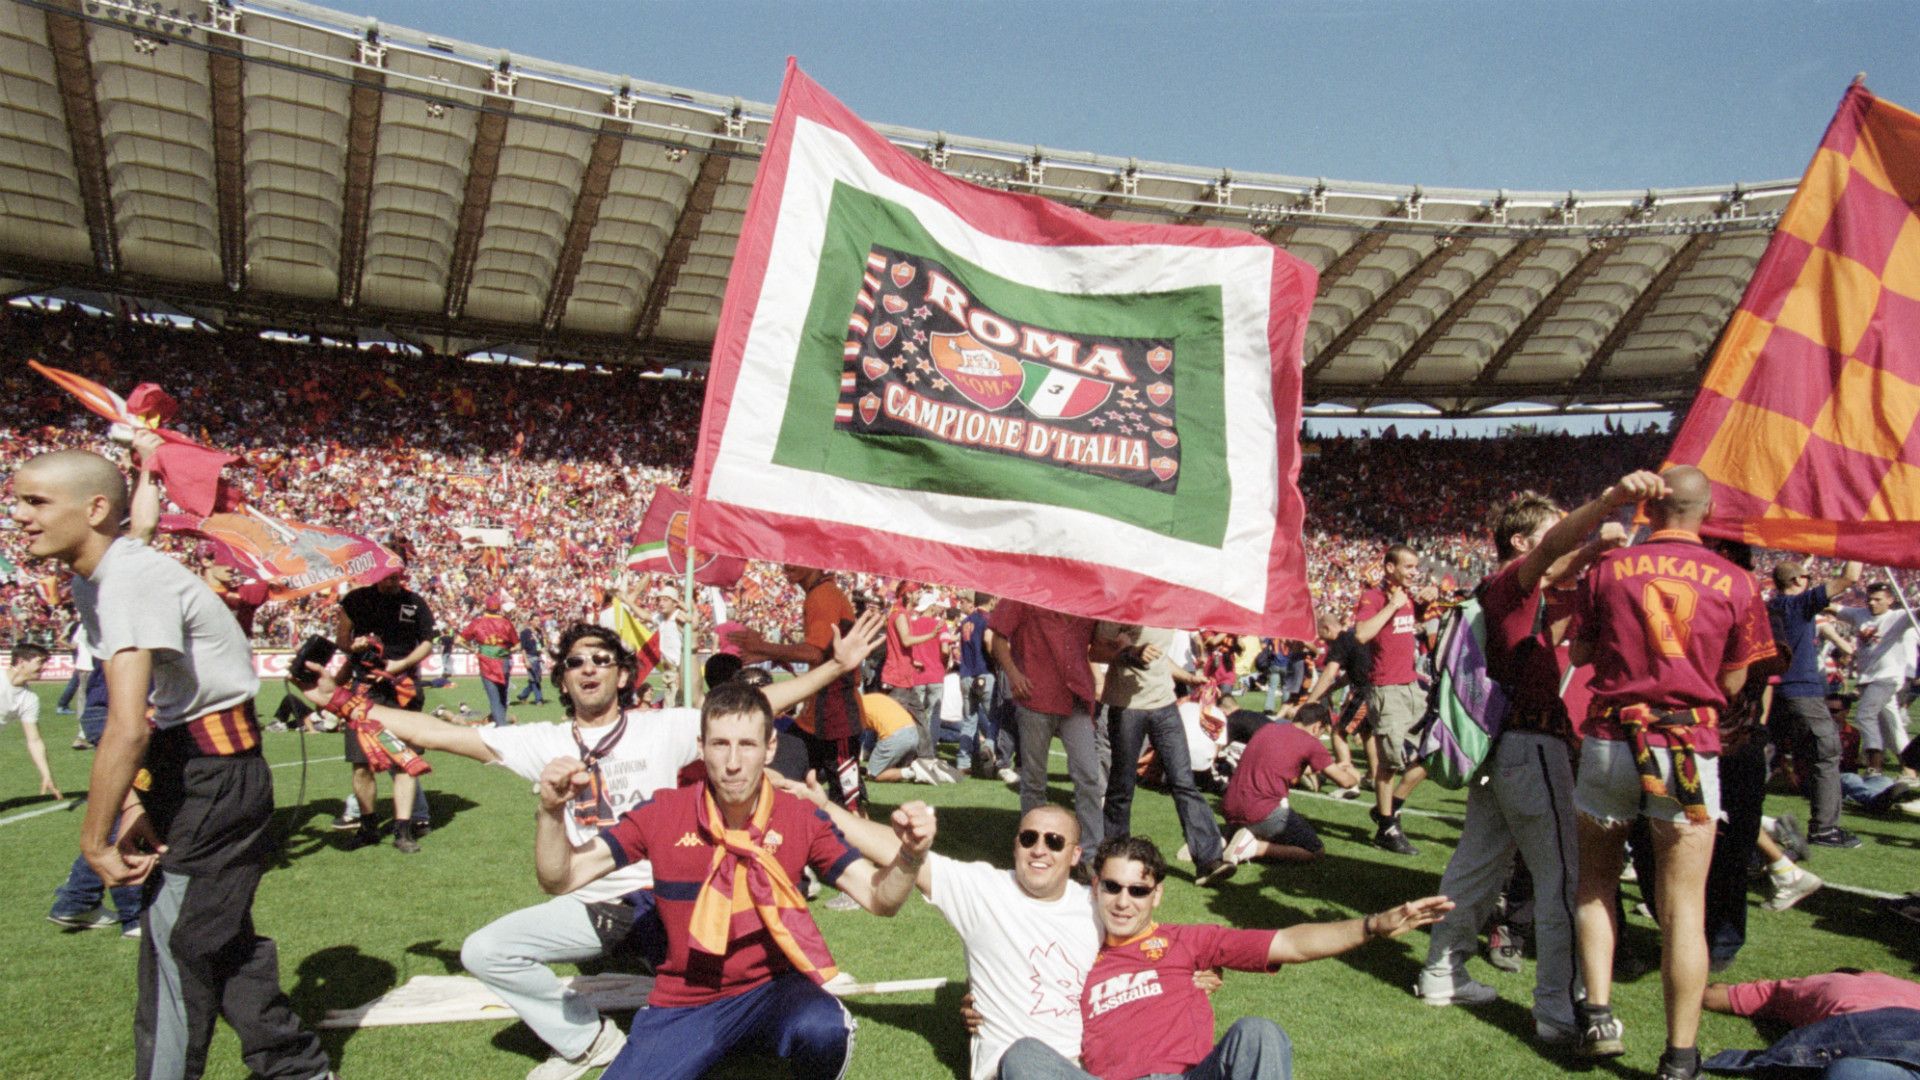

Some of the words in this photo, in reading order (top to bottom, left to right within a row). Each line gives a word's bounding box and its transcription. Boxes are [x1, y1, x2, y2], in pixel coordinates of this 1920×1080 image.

[928, 271, 1135, 382] ROMA
[1047, 384, 1065, 395] 3
[886, 383, 1024, 449] CAMPIONE
[1027, 424, 1147, 467] D'ITALIA
[1613, 555, 1733, 597] NAKATA
